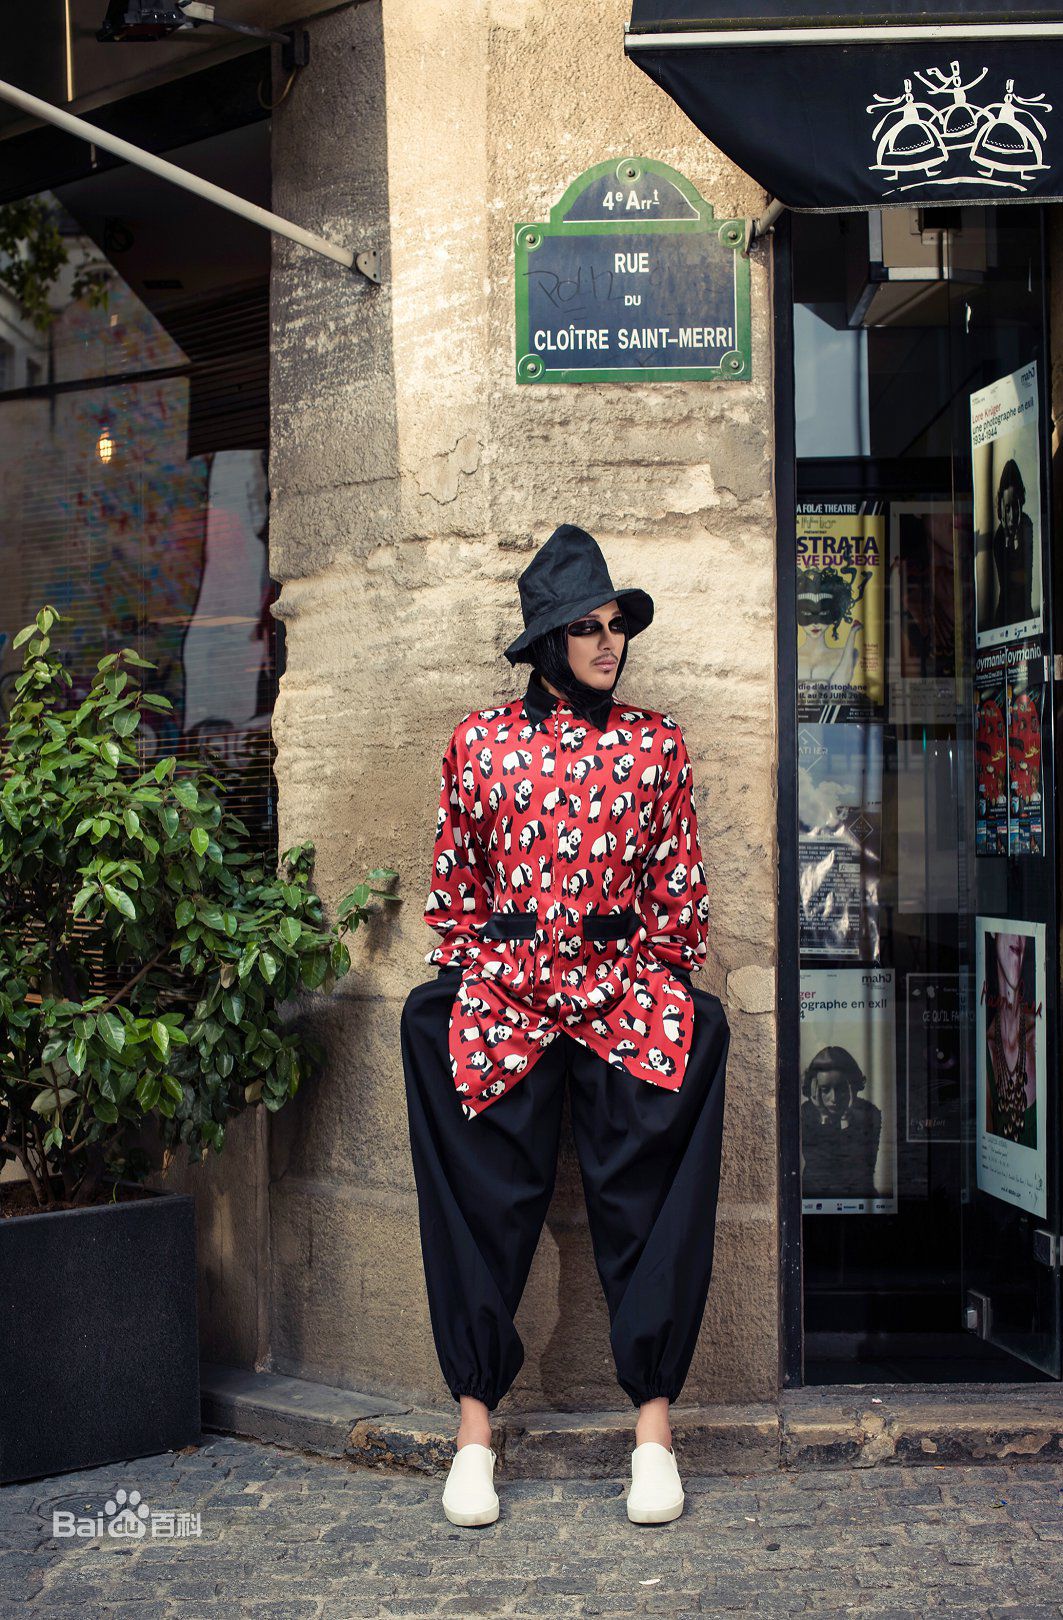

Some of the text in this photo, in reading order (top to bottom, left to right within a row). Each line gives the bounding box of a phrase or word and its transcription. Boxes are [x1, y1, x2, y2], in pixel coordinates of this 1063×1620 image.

[602, 188, 660, 211] 4e Arrt
[614, 252, 650, 274] RUE
[624, 294, 642, 307] DU
[534, 324, 733, 351] CLOÎTRE SAINT-MERRI
[983, 407, 1017, 430] photographe
[823, 503, 857, 514] THEATRE
[796, 536, 879, 554] STRATA
[822, 555, 843, 566] DU
[848, 555, 880, 566] SEXE
[812, 683, 868, 692] d'Aristophane
[800, 998, 887, 1011] ographe en exil
